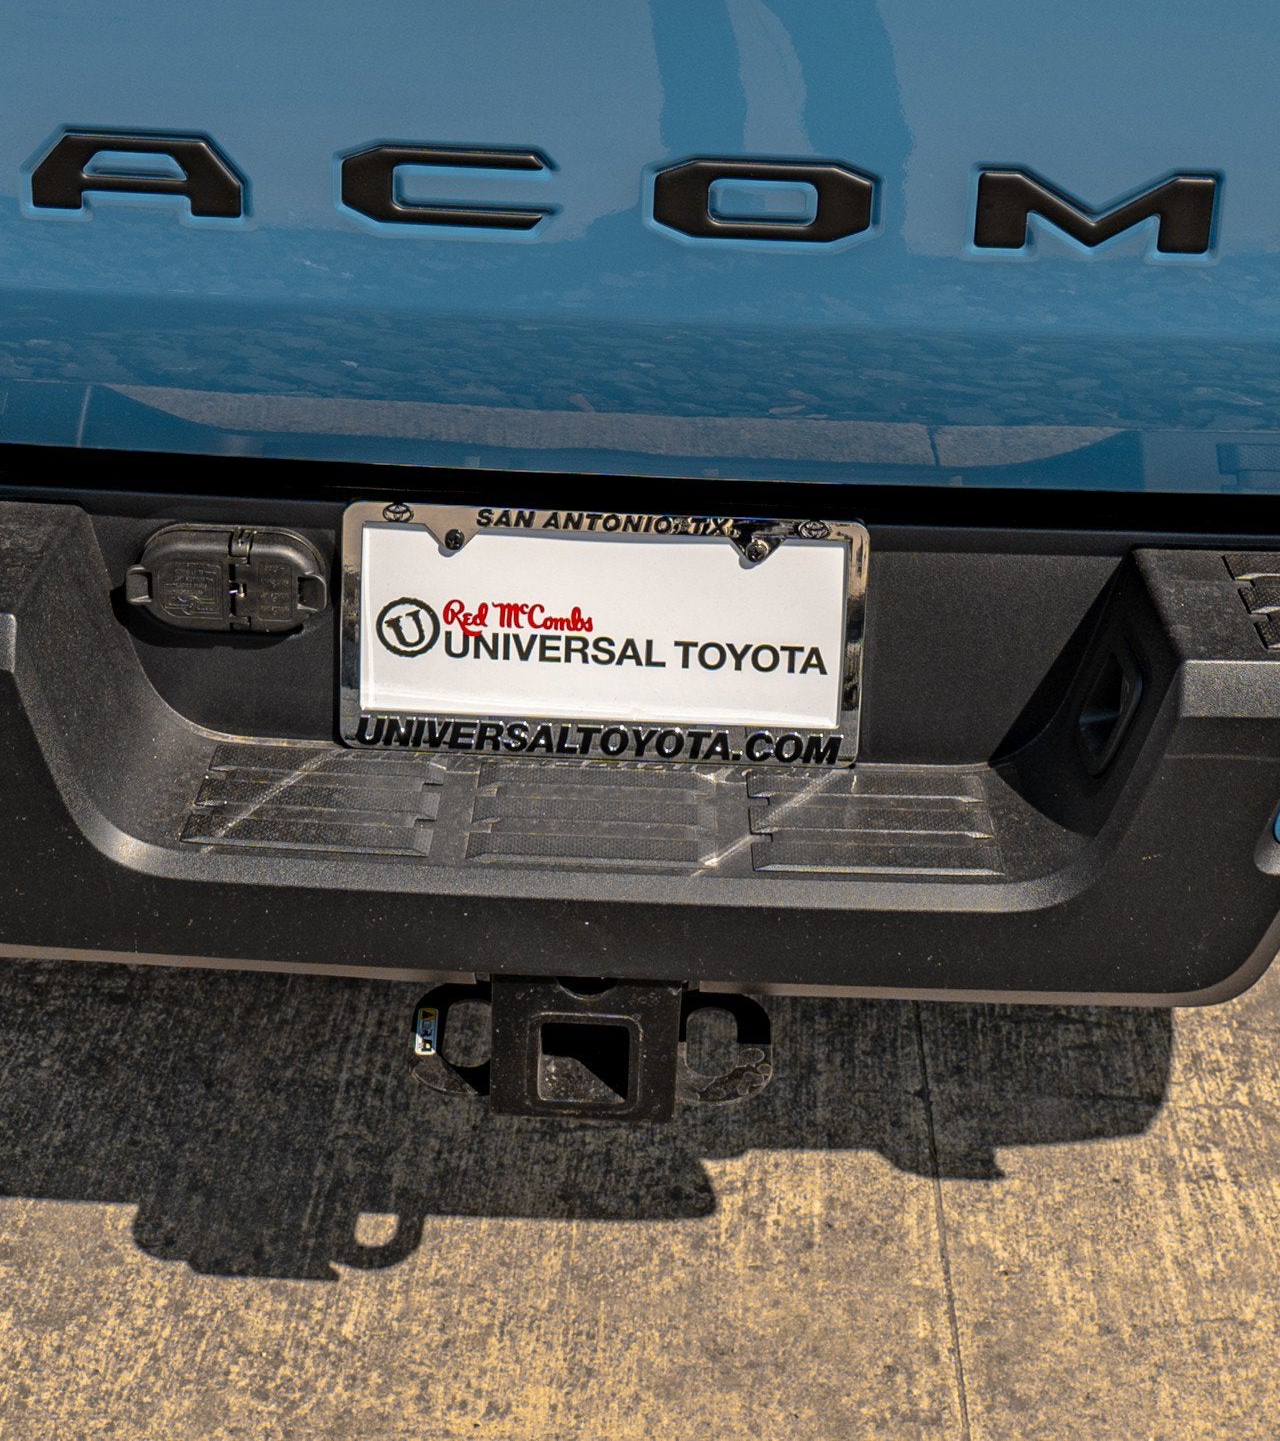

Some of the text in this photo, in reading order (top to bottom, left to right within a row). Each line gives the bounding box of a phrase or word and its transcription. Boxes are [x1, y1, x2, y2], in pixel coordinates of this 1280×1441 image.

[476, 507, 536, 529] SAN
[442, 599, 594, 637] Red McCombs
[444, 630, 829, 676] UNIVERSAL TOYOTA
[355, 714, 845, 765] UNIVERSALTOYOTA.COM
